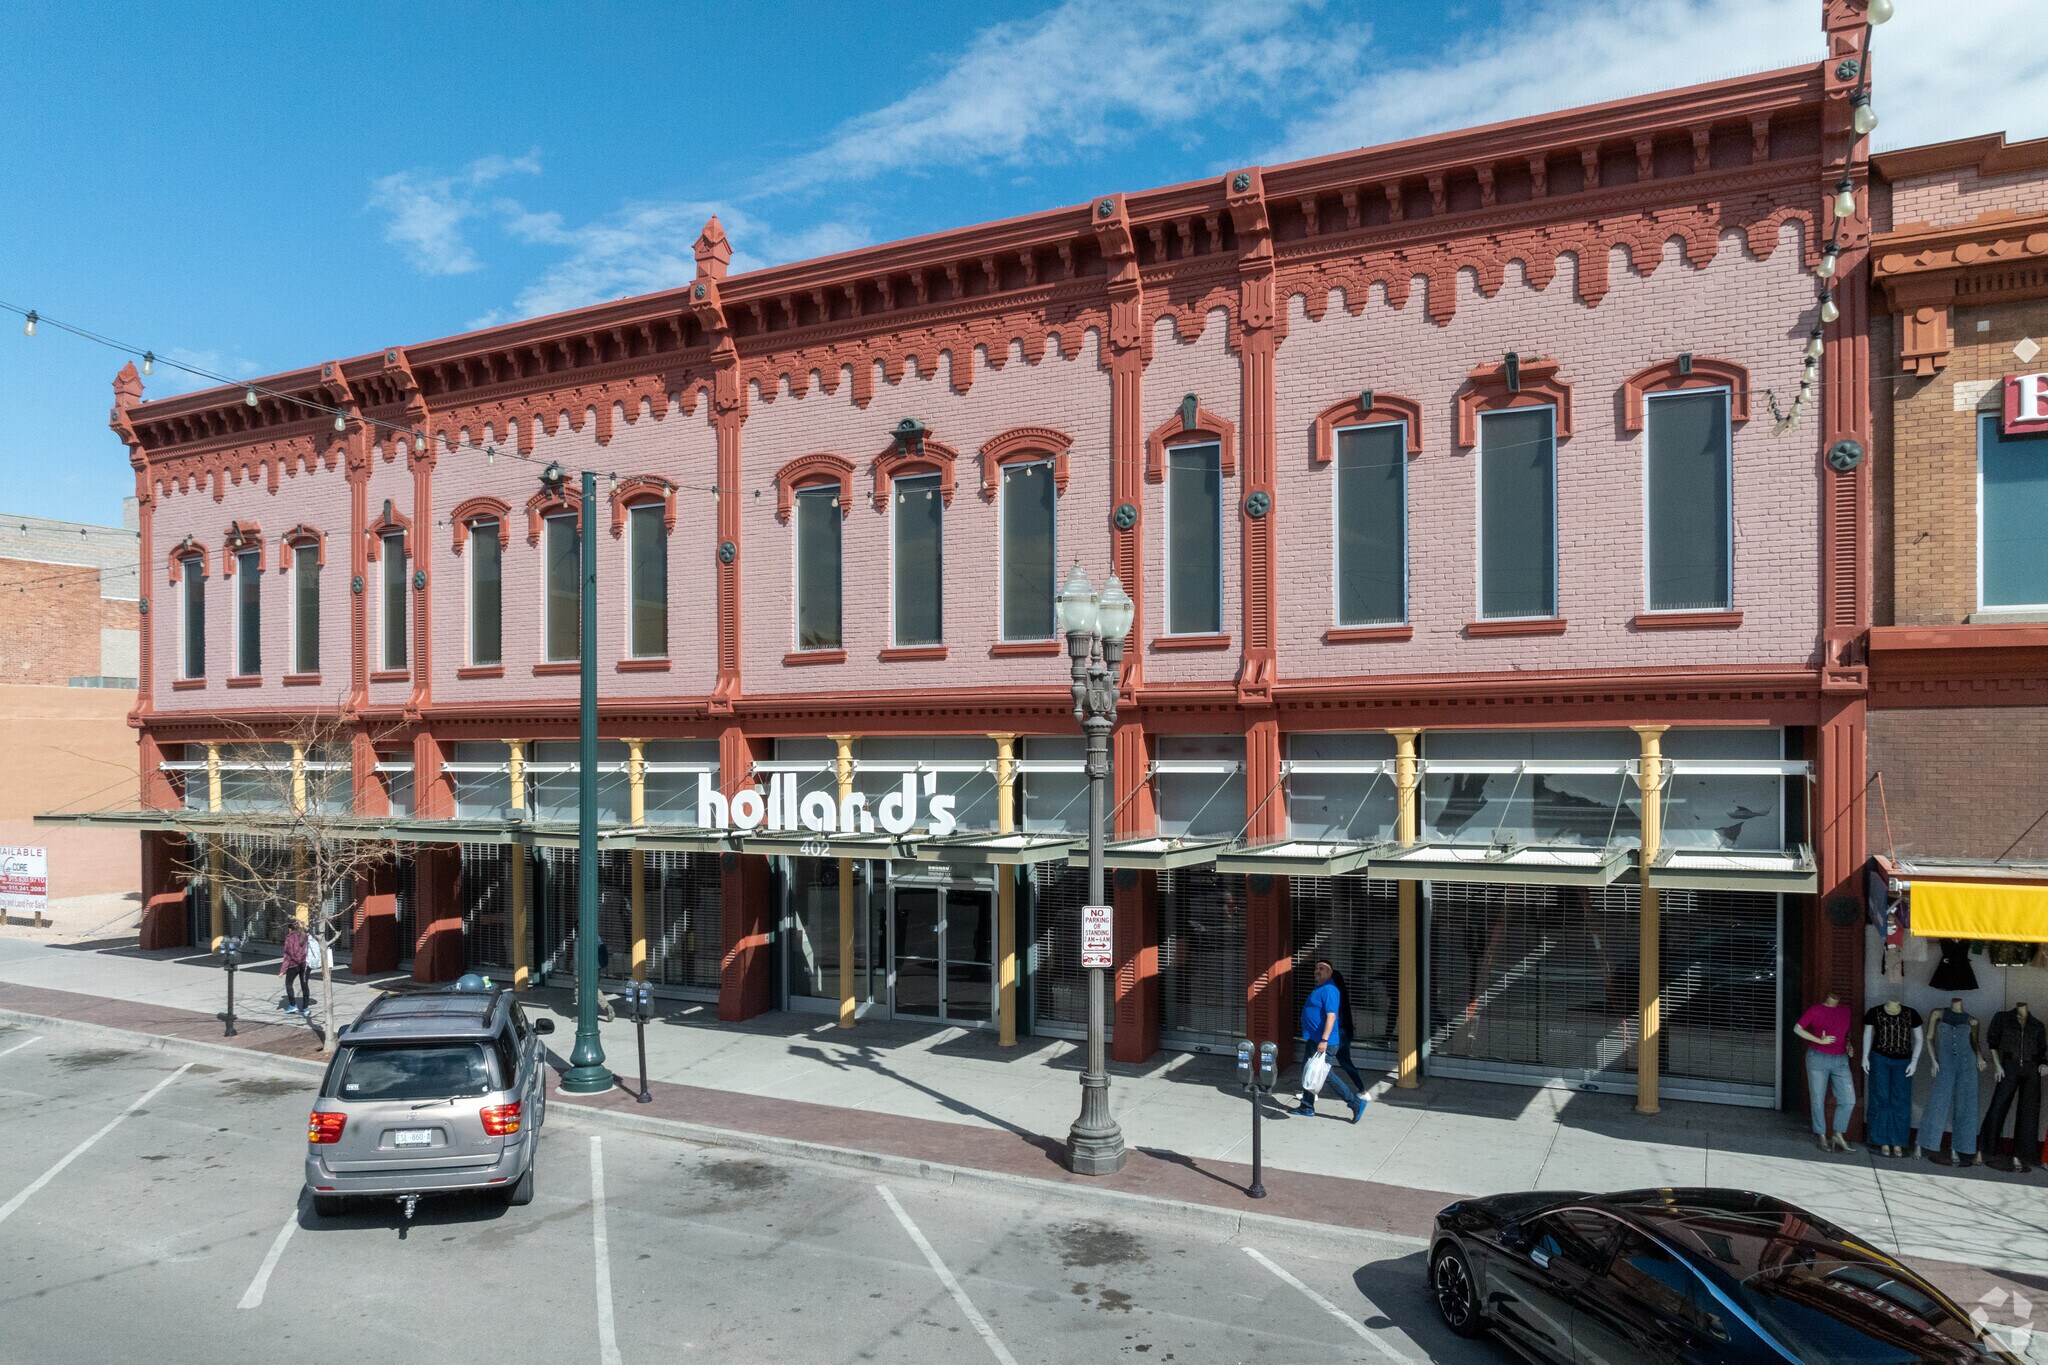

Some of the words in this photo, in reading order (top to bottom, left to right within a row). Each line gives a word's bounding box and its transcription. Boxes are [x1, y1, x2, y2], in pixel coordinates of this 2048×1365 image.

[698, 770, 957, 835] holland's
[800, 841, 830, 857] 402
[12, 863, 28, 872] CORE
